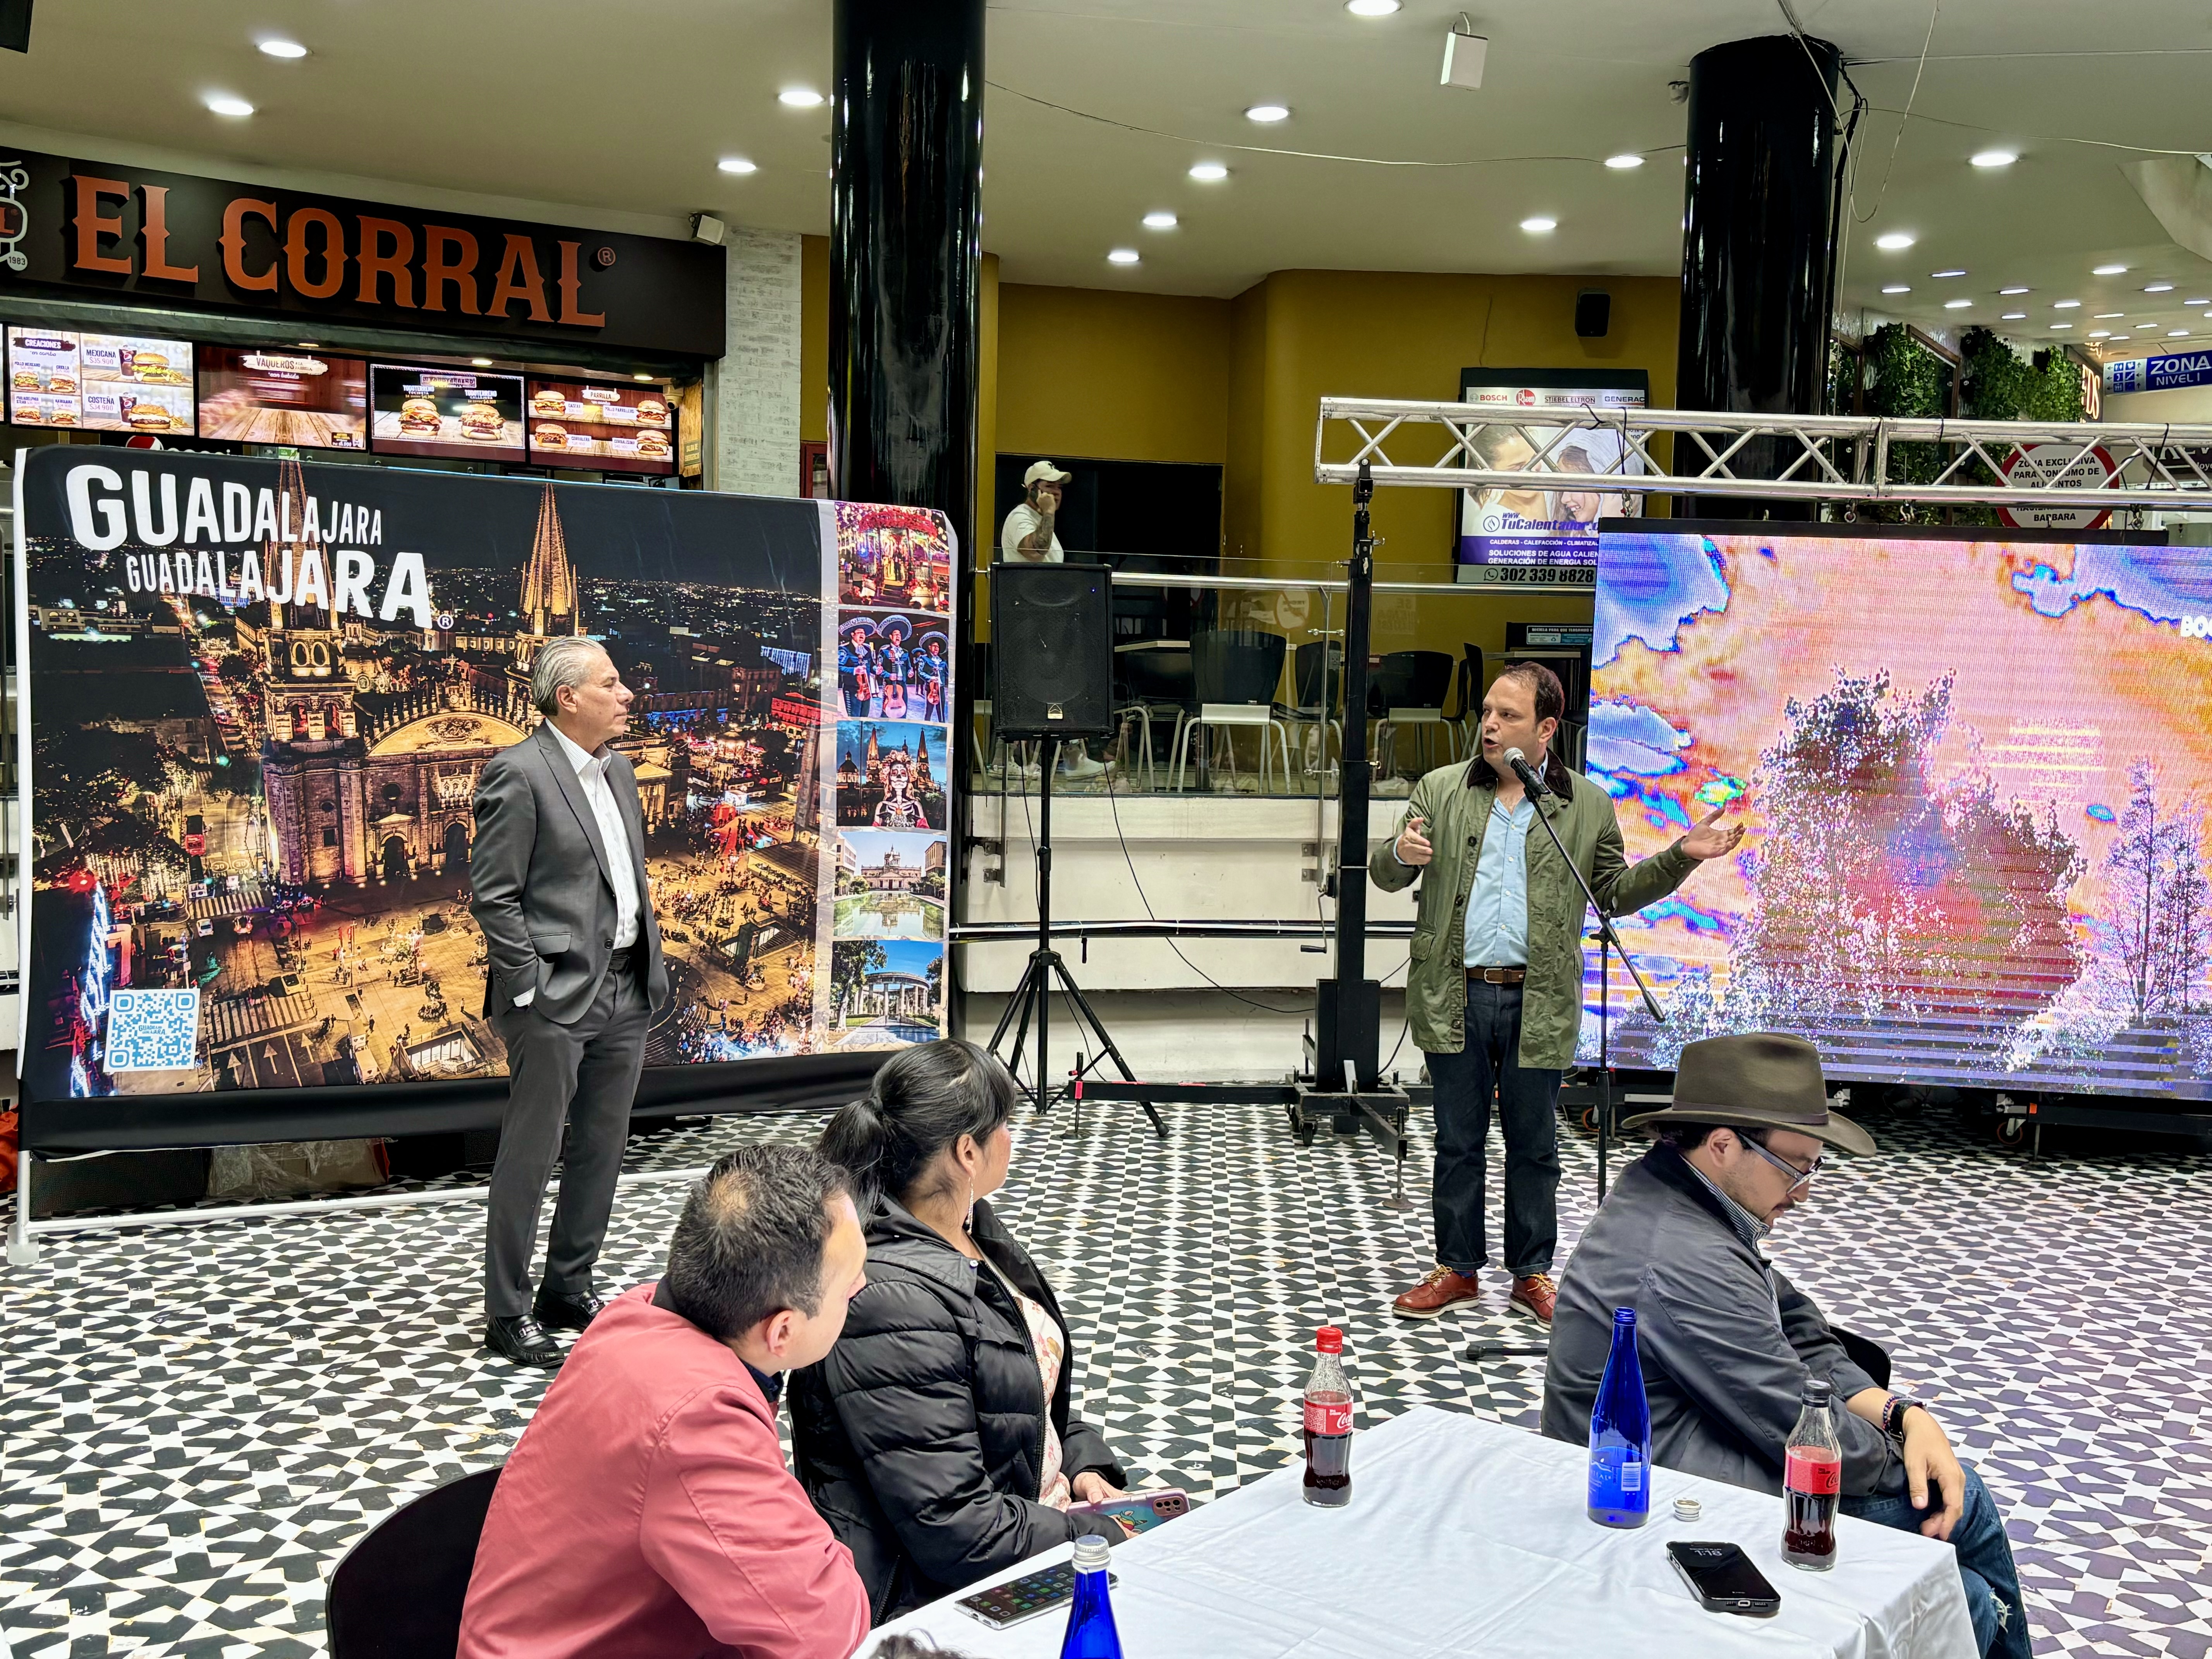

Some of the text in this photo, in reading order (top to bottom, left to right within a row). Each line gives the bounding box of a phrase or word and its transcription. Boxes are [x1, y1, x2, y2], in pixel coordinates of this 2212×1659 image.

[72, 174, 199, 283] EL
[9, 256, 26, 265] 1983
[25, 338, 62, 349] CREACIONES
[86, 349, 116, 358] MEXICANA
[256, 357, 294, 369] VAQUEROS
[2150, 355, 2210, 375] ZONA
[2156, 374, 2194, 386] NIVEL
[88, 396, 115, 405] COSTEÑA
[66, 465, 382, 551] GUADALAJARA
[1488, 557, 1536, 565] GENERACIÓN
[1500, 567, 1594, 583] 302 339 8828
[2181, 615, 2212, 638] BO
